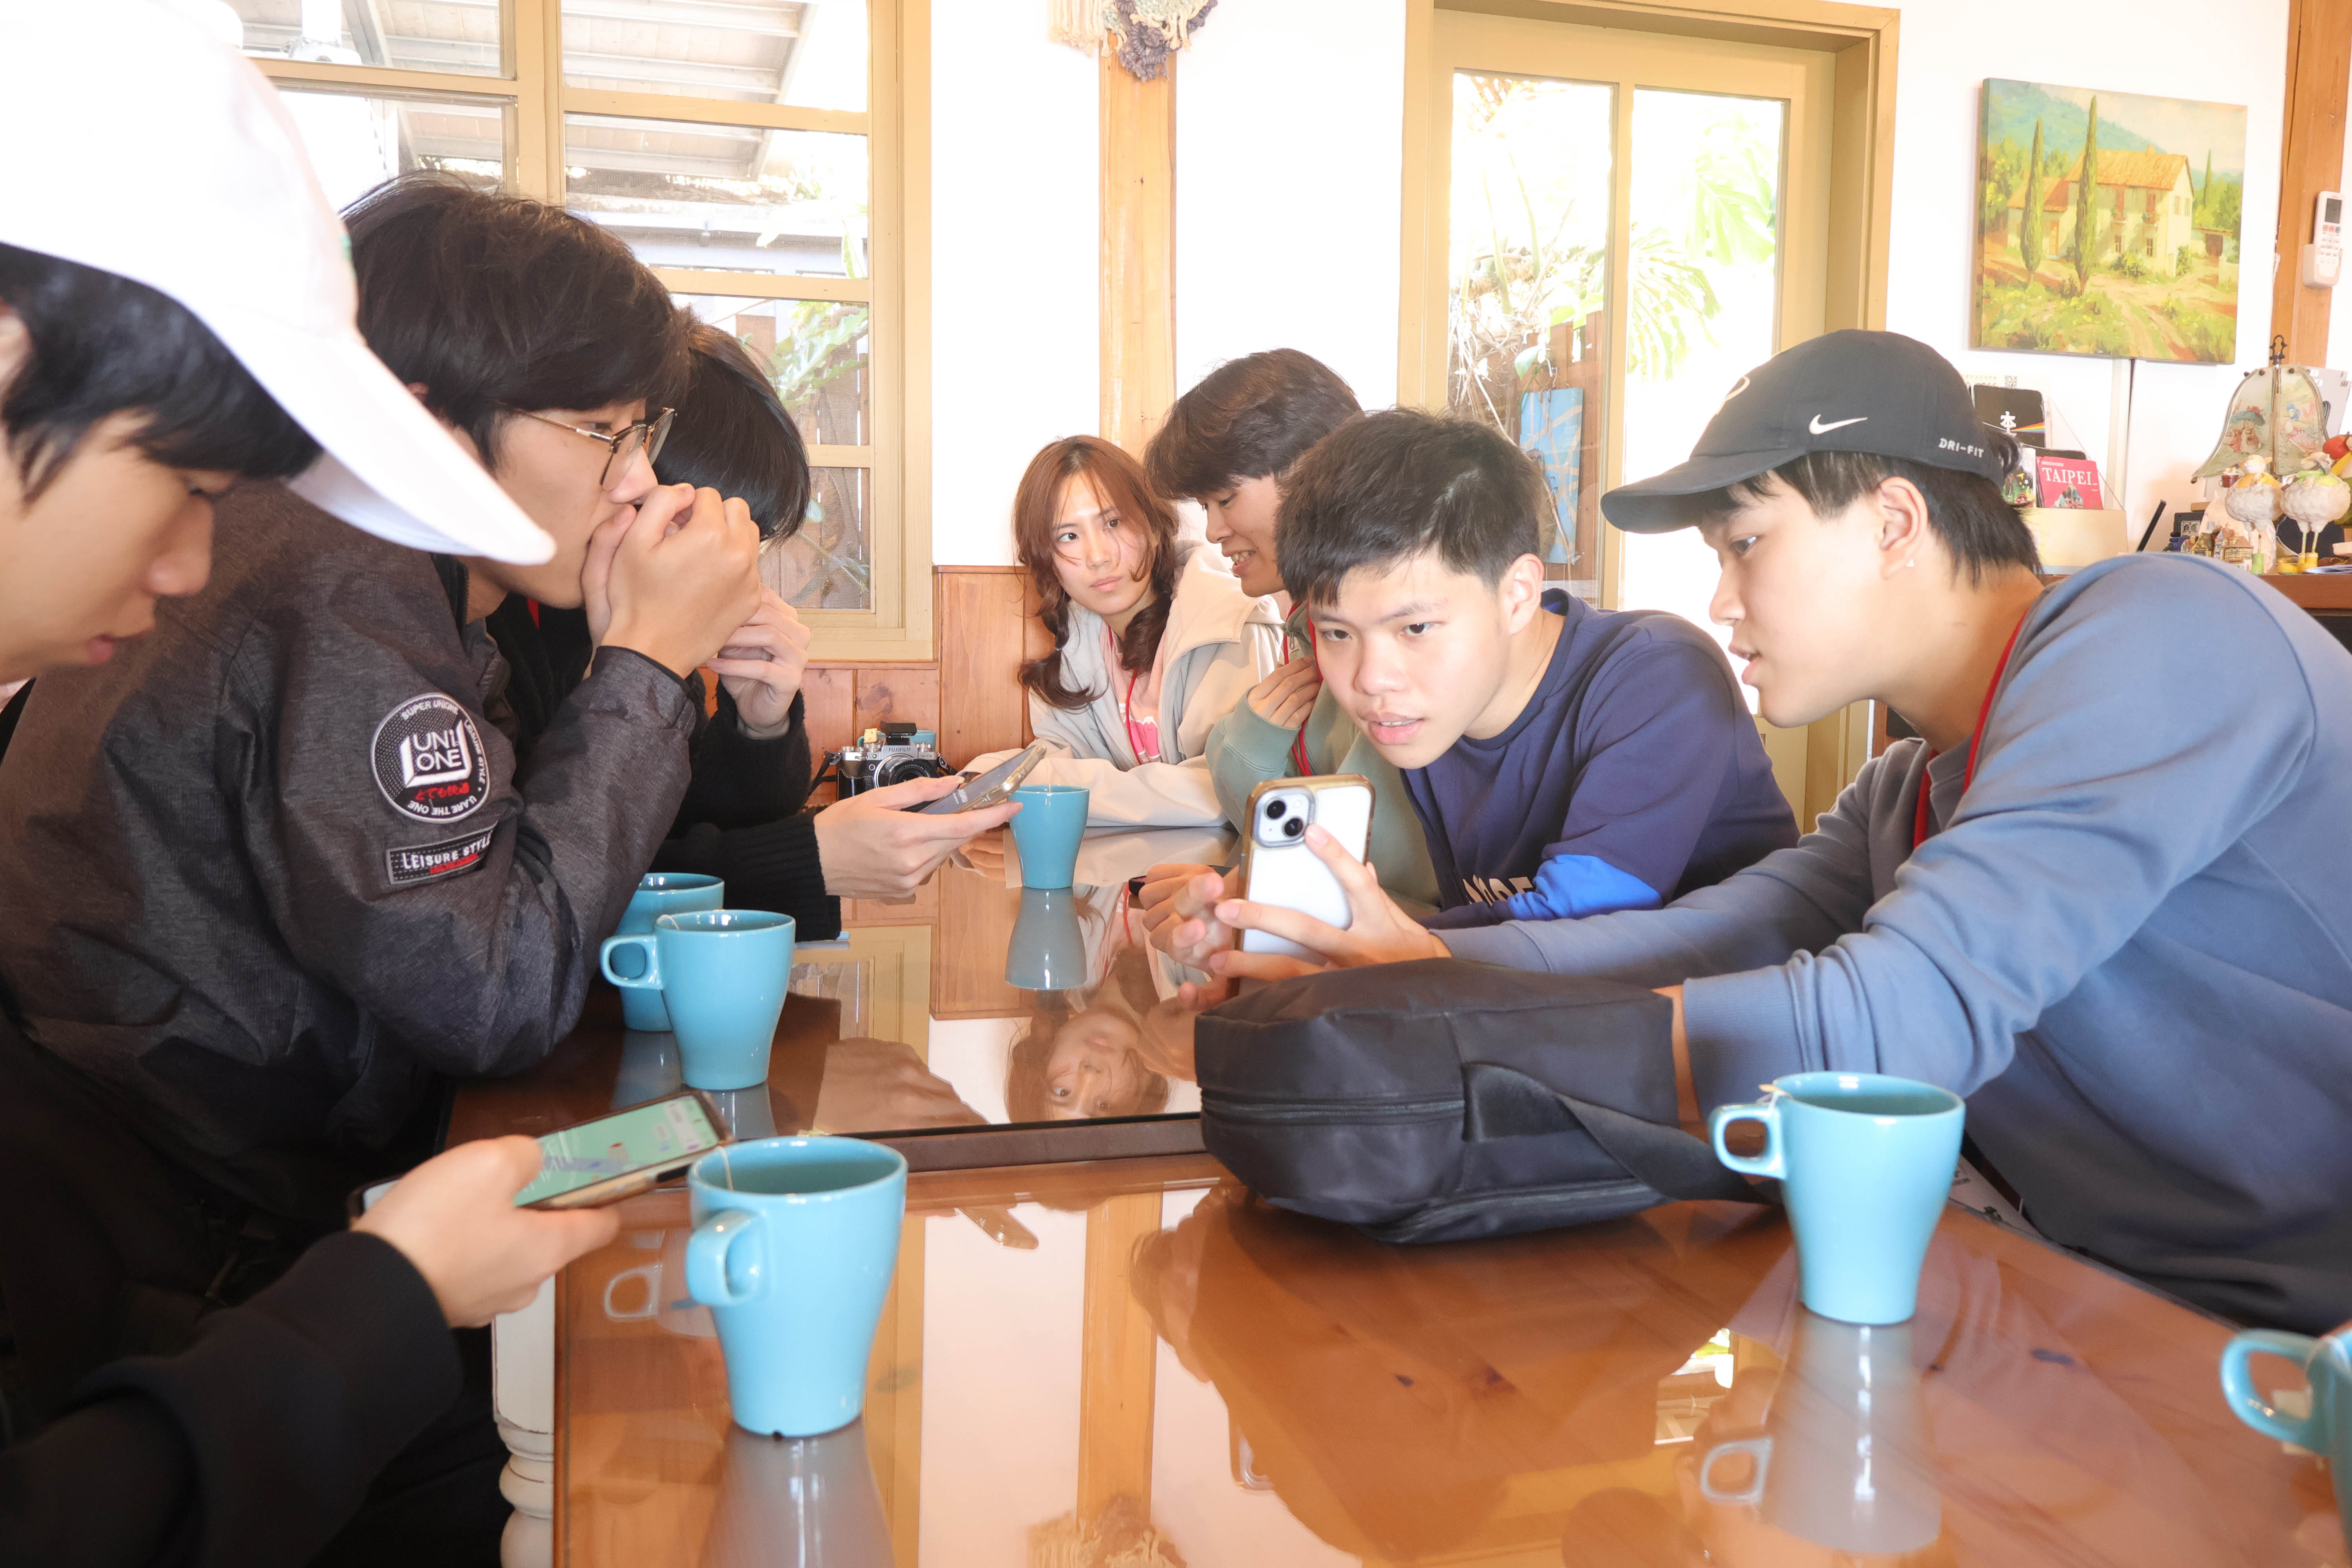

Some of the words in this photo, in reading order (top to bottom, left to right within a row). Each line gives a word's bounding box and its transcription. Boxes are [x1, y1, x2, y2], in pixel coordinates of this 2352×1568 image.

[1938, 437, 1984, 458] DRI-FIT
[2042, 467, 2092, 485] TAIPEI
[401, 701, 432, 720] SUPER
[416, 748, 462, 771] ONE
[464, 719, 482, 755] LEISURE
[477, 756, 486, 784] STYLE
[407, 800, 430, 814] ONE
[431, 806, 451, 816] THE
[401, 850, 459, 869] LEISURE
